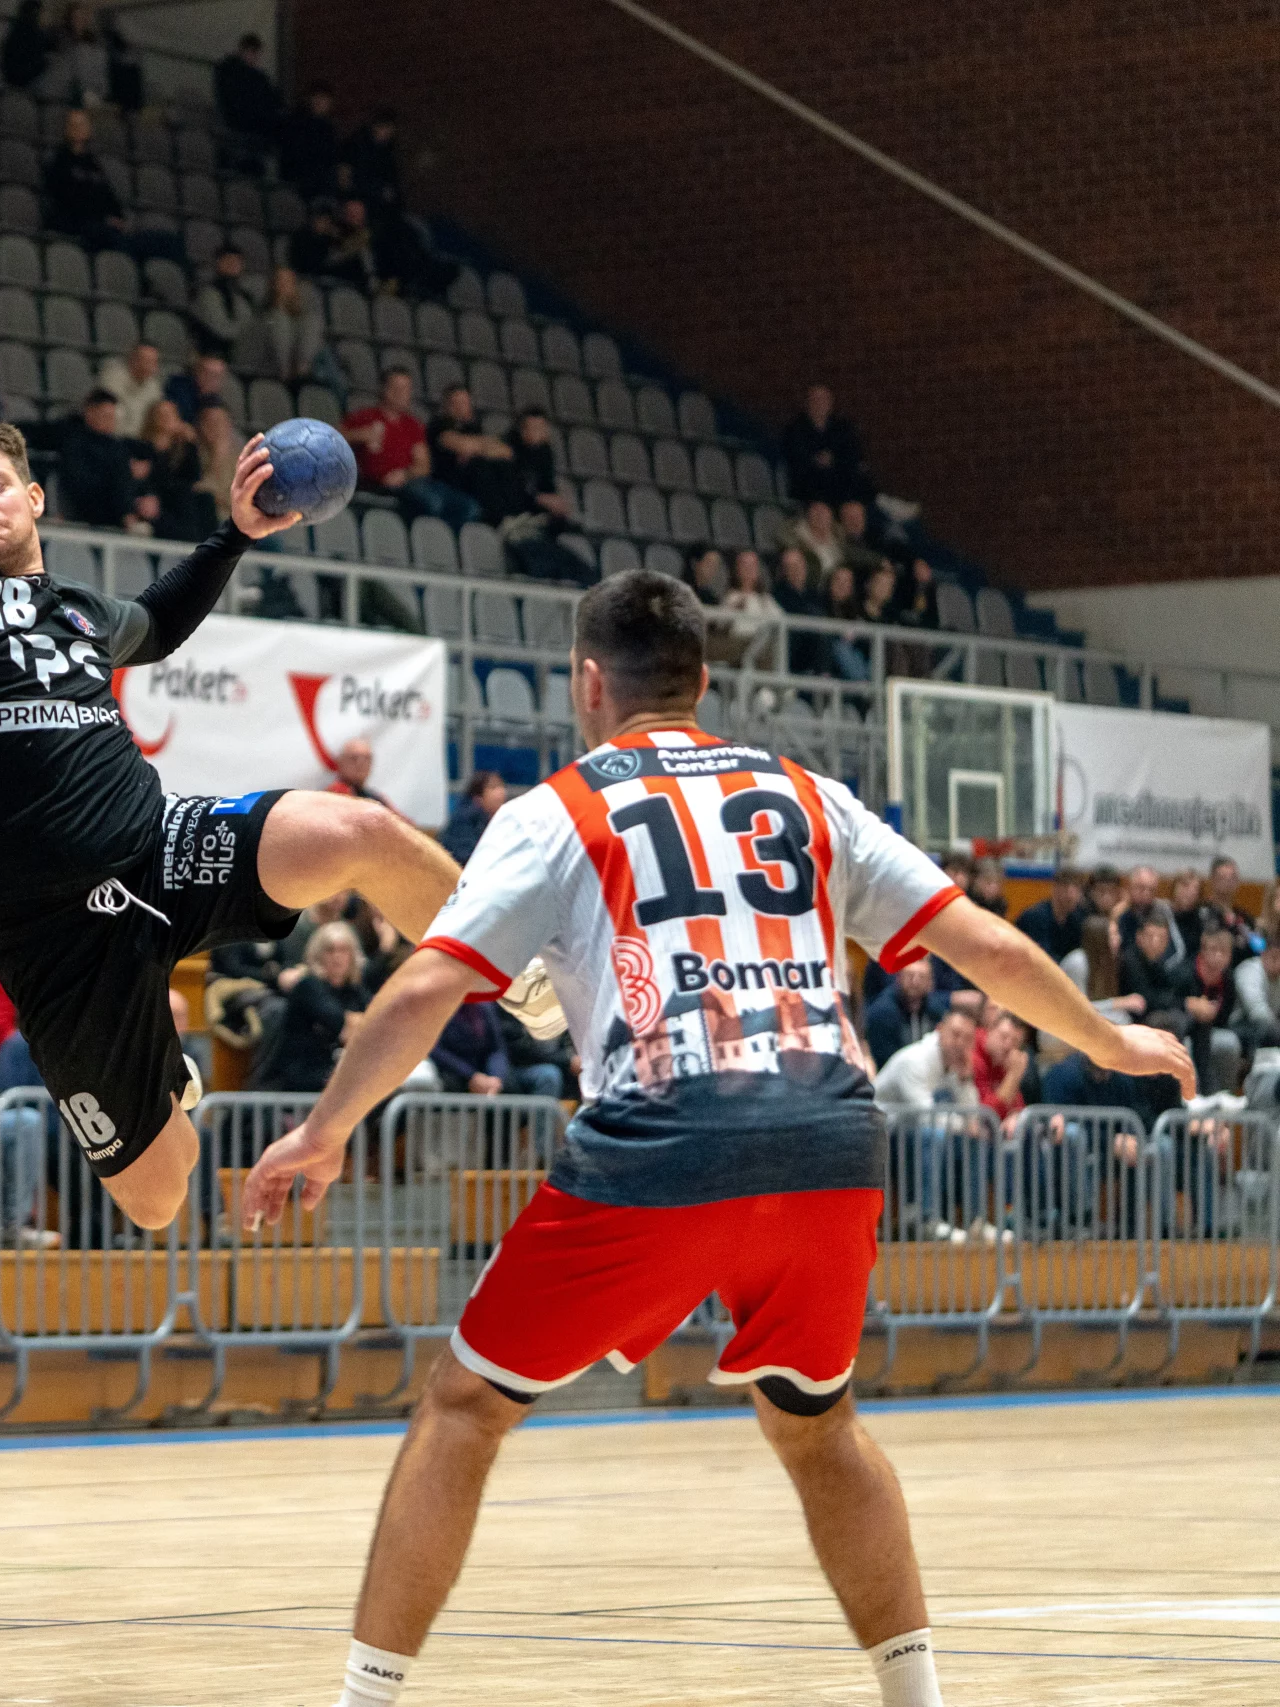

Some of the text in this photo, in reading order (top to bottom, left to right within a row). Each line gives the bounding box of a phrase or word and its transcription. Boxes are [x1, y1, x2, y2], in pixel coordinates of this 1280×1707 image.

[662, 758, 739, 773] Lončar
[193, 834, 217, 884] biro
[611, 789, 816, 926] 13
[671, 952, 830, 993] Bomar
[59, 1092, 116, 1148] 18
[86, 1138, 124, 1161] Kempa
[884, 1643, 927, 1662] JAKO
[361, 1664, 404, 1681] JAKO
